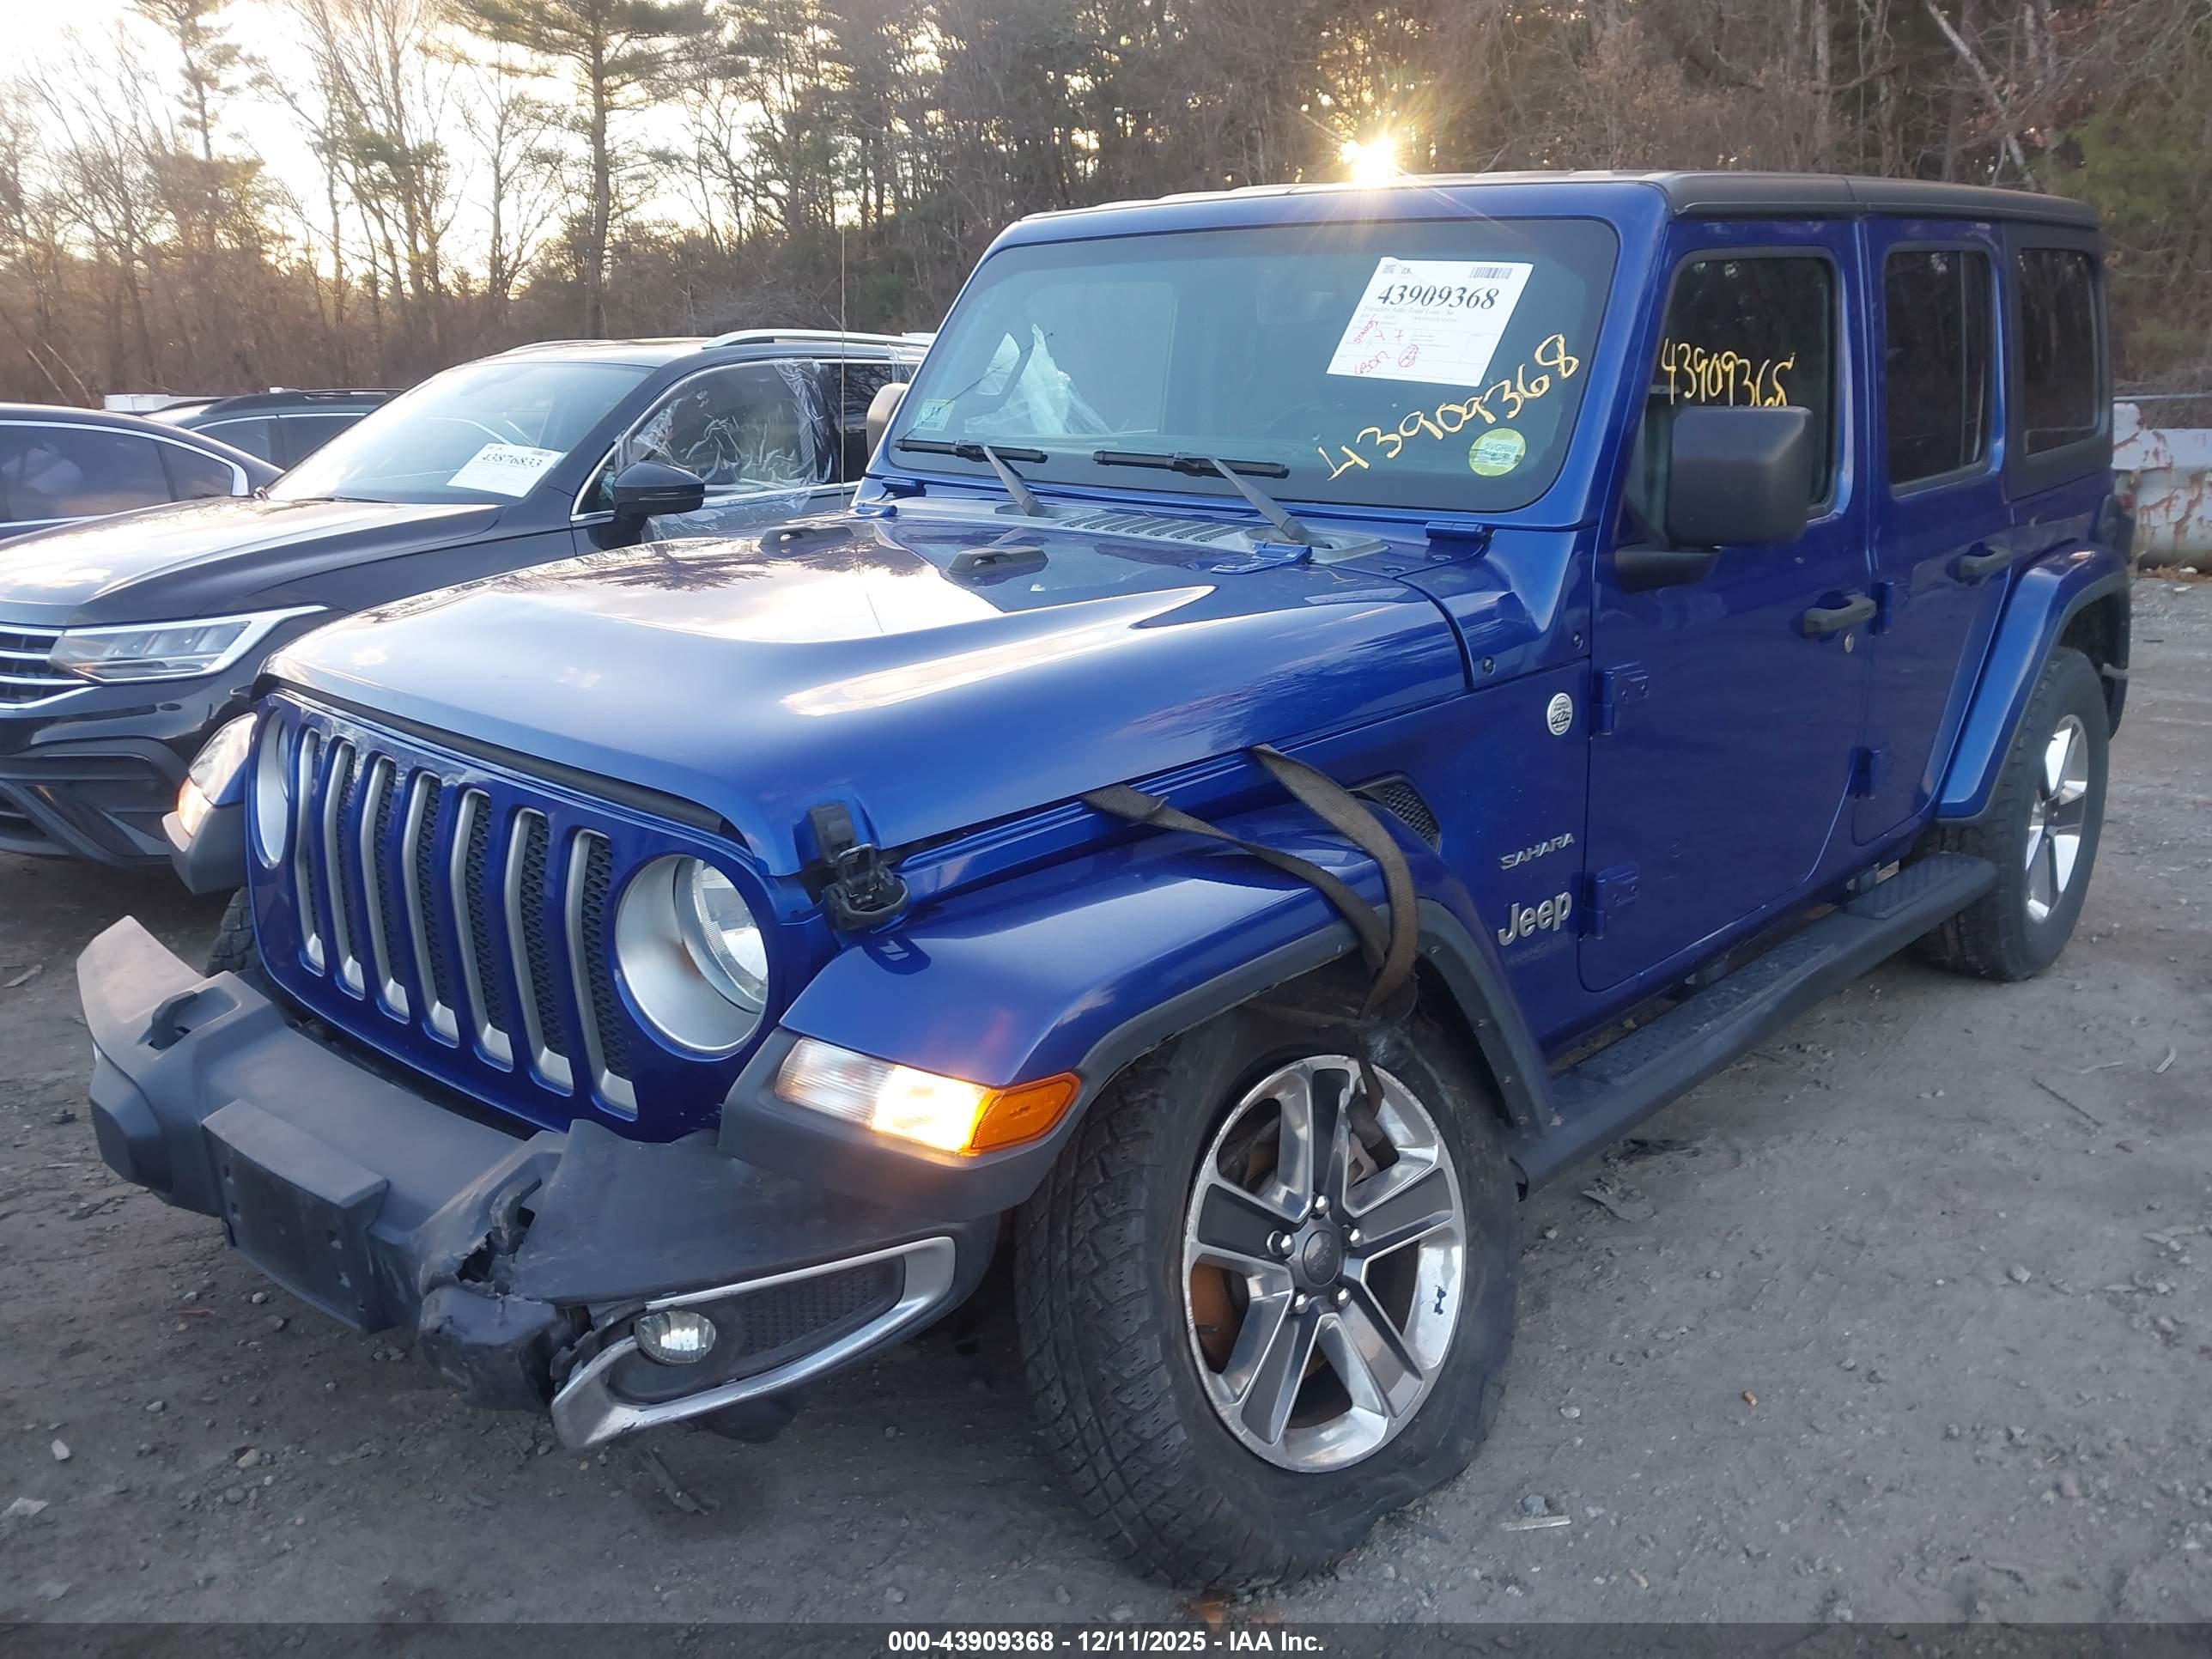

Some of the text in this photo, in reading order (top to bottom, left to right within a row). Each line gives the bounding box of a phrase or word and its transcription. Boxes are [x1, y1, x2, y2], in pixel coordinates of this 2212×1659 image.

[1377, 283, 1499, 310] 43909368
[1318, 333, 1579, 481] 43909368
[1499, 832, 1575, 871] SAHARA
[1498, 890, 1573, 947] Jeep
